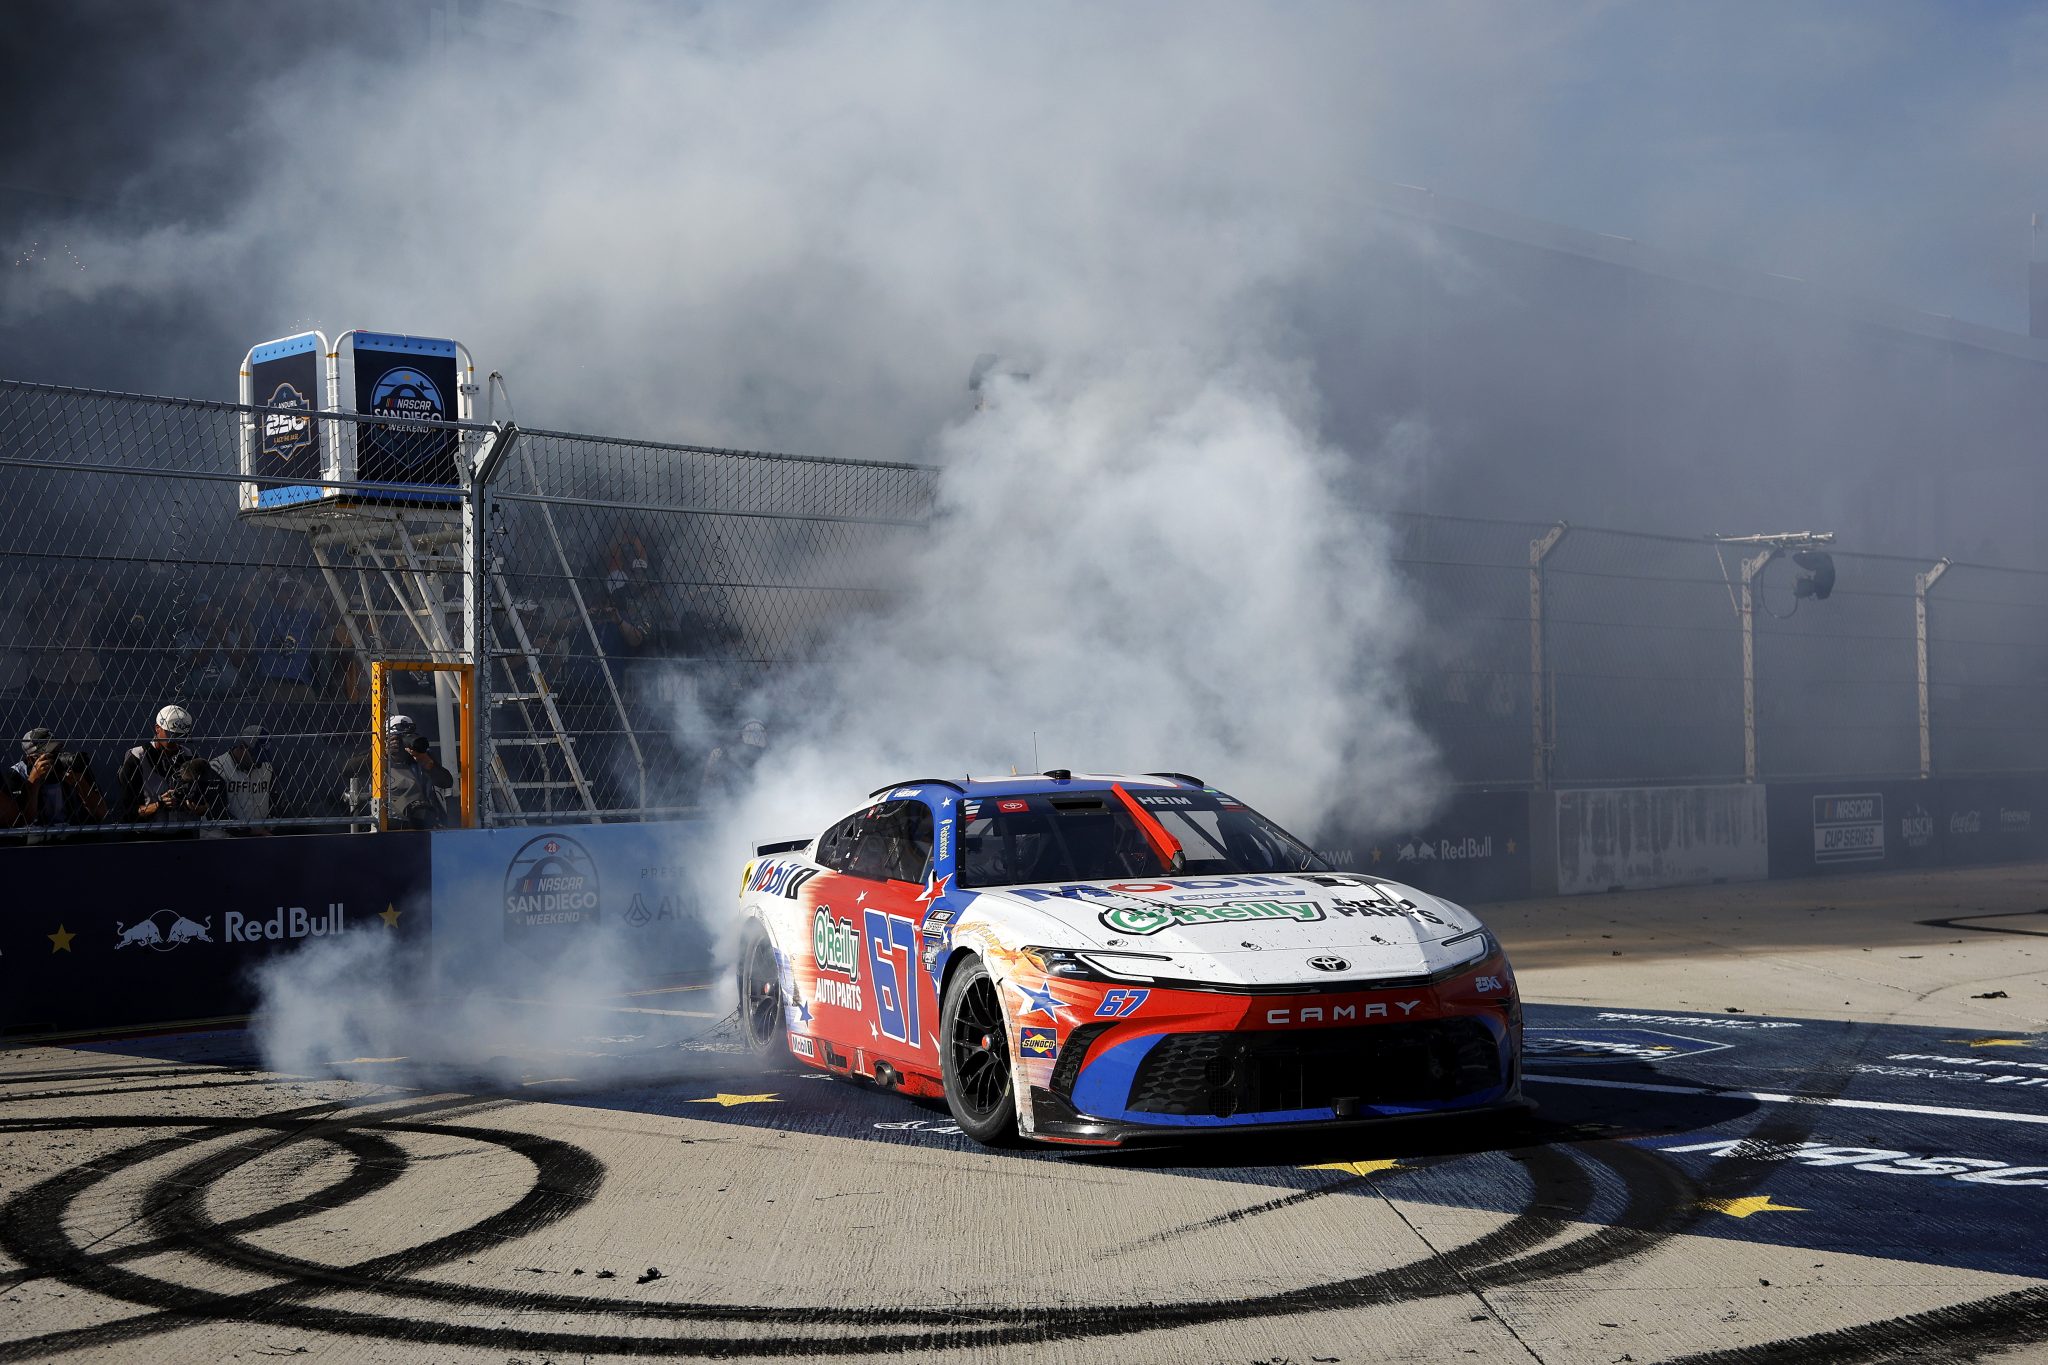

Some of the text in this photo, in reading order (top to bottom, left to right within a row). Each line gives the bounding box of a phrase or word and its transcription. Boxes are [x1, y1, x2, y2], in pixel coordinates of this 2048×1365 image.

[397, 399, 431, 411] NASCAR
[388, 424, 429, 434] WEEKEND
[227, 781, 268, 794] OFFICIA
[1137, 796, 1192, 805] HEIM
[1836, 799, 1873, 818] NASCAR
[1824, 828, 1875, 848] CUP SERIES
[1902, 817, 1934, 838] BUSCH
[1441, 836, 1492, 860] Red Bull
[537, 877, 584, 892] NASCAR
[749, 859, 802, 897] Mobil
[1006, 876, 1295, 903] Mobil
[506, 892, 598, 914] SAN DIEGO
[225, 903, 344, 943] Red Bull
[526, 911, 580, 926] WEEKEND
[813, 907, 860, 980] O'Reilly
[863, 907, 921, 1049] 67
[815, 977, 862, 1012] AUTO PARTS
[1094, 988, 1150, 1017] 67
[1267, 1000, 1421, 1024] CAMRY
[1023, 1039, 1055, 1049] SUNOCO
